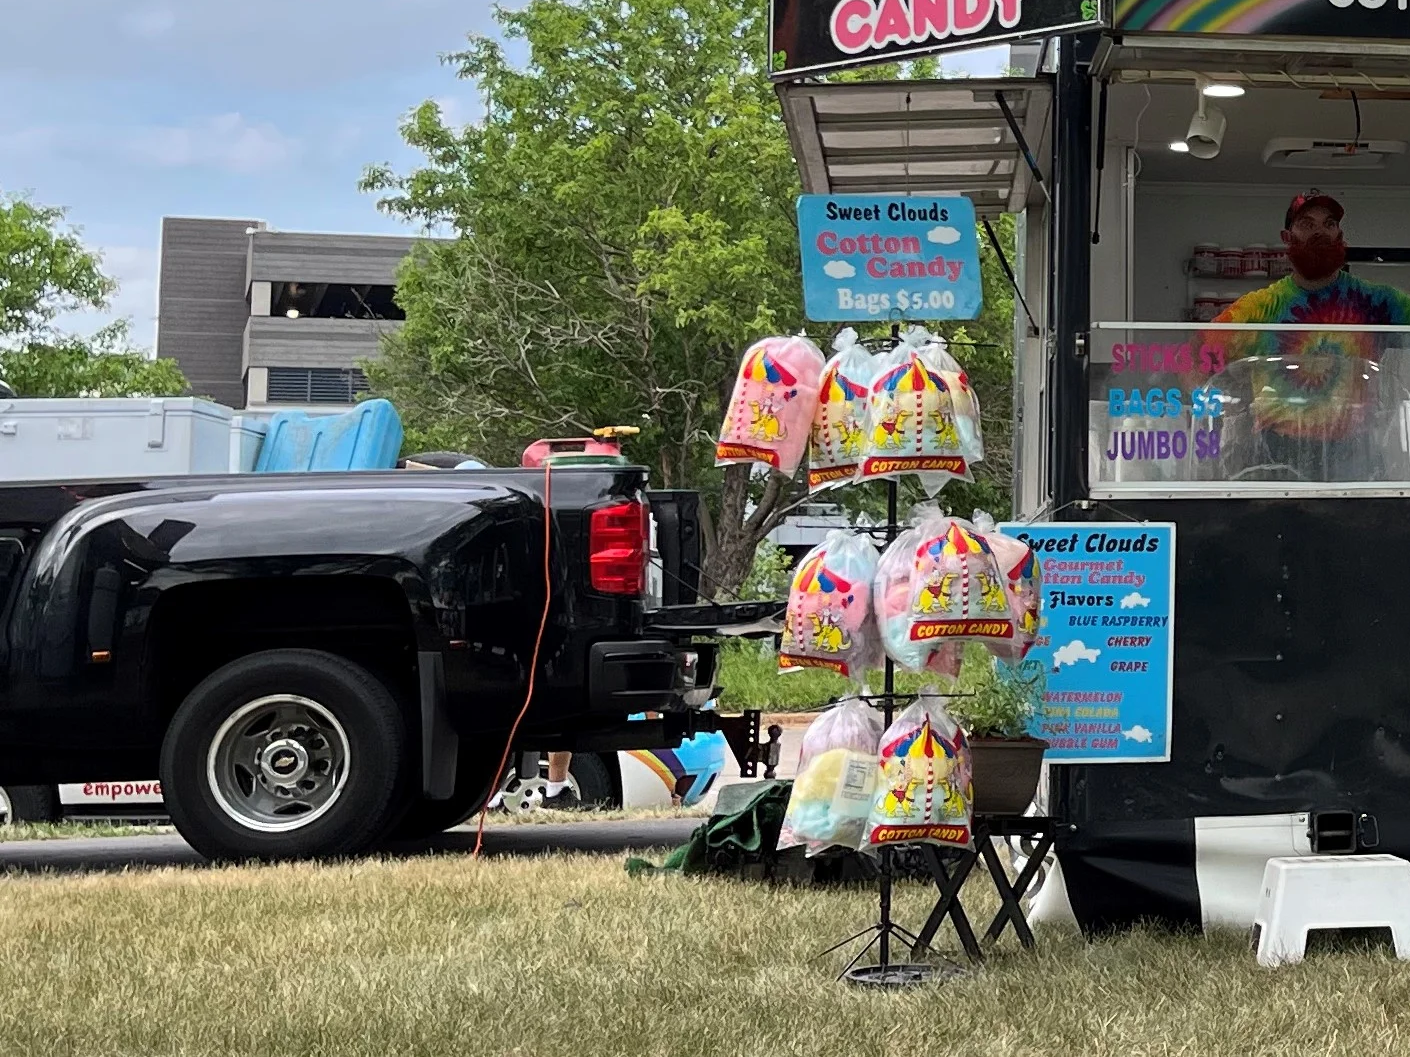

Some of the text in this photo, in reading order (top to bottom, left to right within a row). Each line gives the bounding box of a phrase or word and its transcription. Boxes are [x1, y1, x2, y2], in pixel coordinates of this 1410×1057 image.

[826, 202, 949, 222] Sweet Clouds
[816, 231, 921, 255] Cotton
[866, 256, 964, 282] Candy
[837, 288, 955, 314] Bags $5.00
[1111, 343, 1193, 374] STICKS
[1108, 387, 1224, 420] BAGS $5
[1107, 429, 1220, 460] JUMBO $8
[870, 460, 918, 473] COTTON
[921, 460, 962, 472] CANDY
[1085, 533, 1159, 553] Clouds
[1043, 558, 1124, 571] Gourmet
[1042, 571, 1146, 588] tton Candy
[1050, 591, 1114, 609] Flavors
[1069, 615, 1168, 627] BLUE RASPBERRY
[917, 622, 1008, 638] COTTON CANDY
[1107, 635, 1152, 647] CHERRY
[1110, 661, 1149, 672] GRAPE
[1043, 691, 1122, 702] WATERMELON
[1075, 722, 1122, 734] VANILLA
[83, 782, 162, 800] empowe
[878, 828, 926, 841] COTTON
